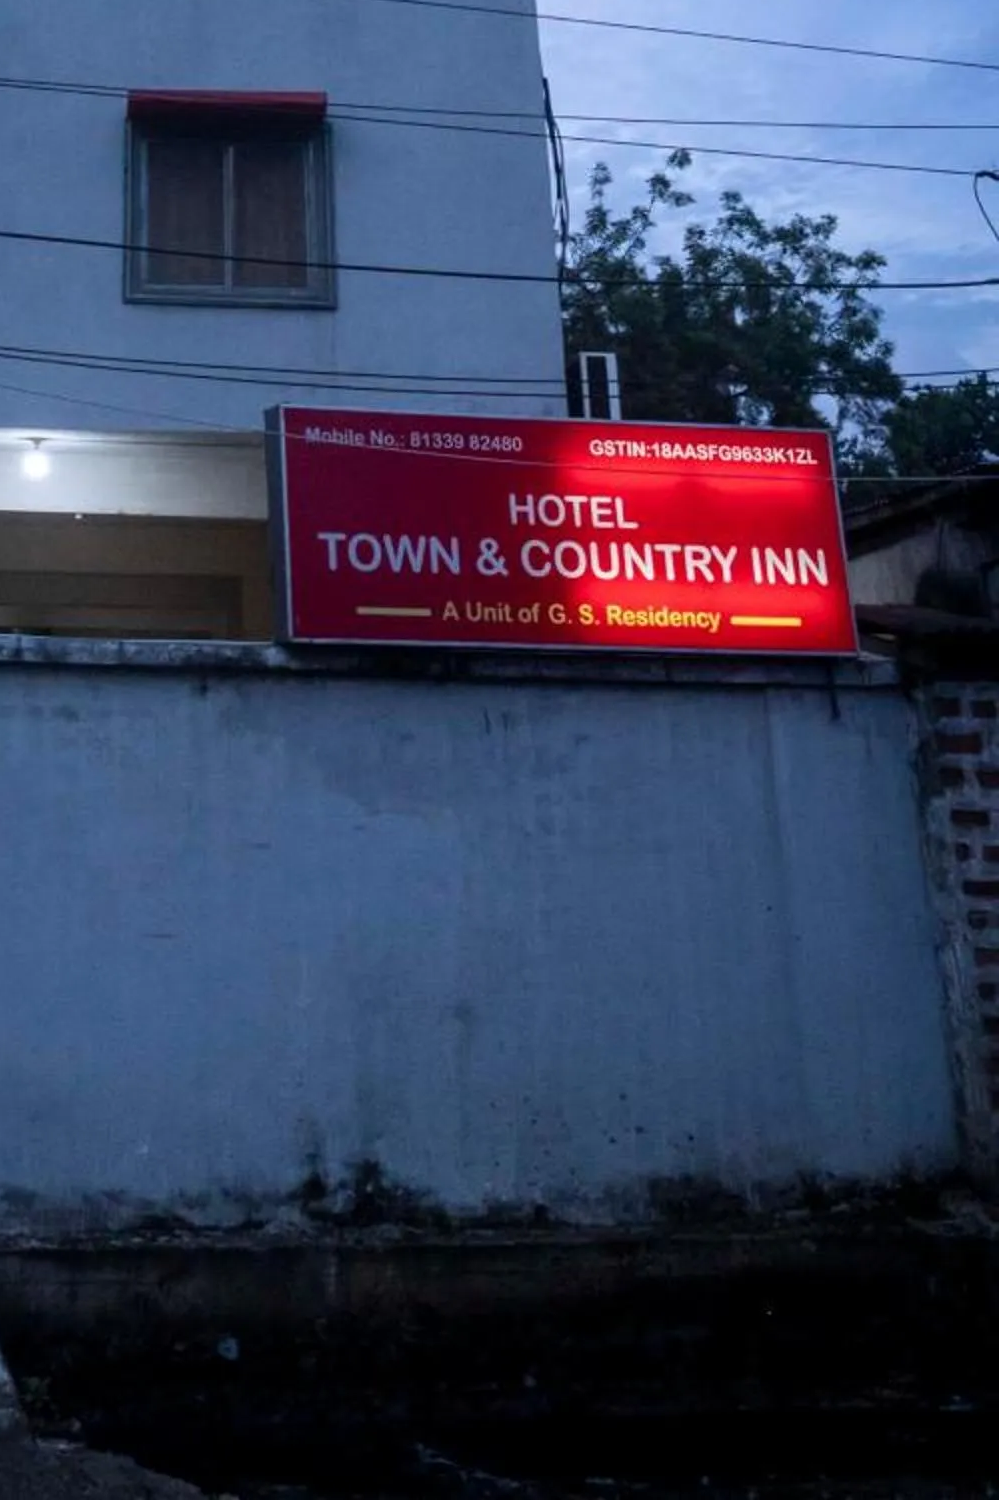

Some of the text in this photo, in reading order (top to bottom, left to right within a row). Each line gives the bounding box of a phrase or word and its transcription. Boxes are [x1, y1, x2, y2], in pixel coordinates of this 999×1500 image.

[305, 427, 364, 445] Mobile
[410, 430, 464, 449] 81339
[508, 493, 639, 529] HOTEL
[317, 532, 829, 586] TOWN & COUNTRY INN
[442, 601, 722, 633] A Unit of G. S. Residency
